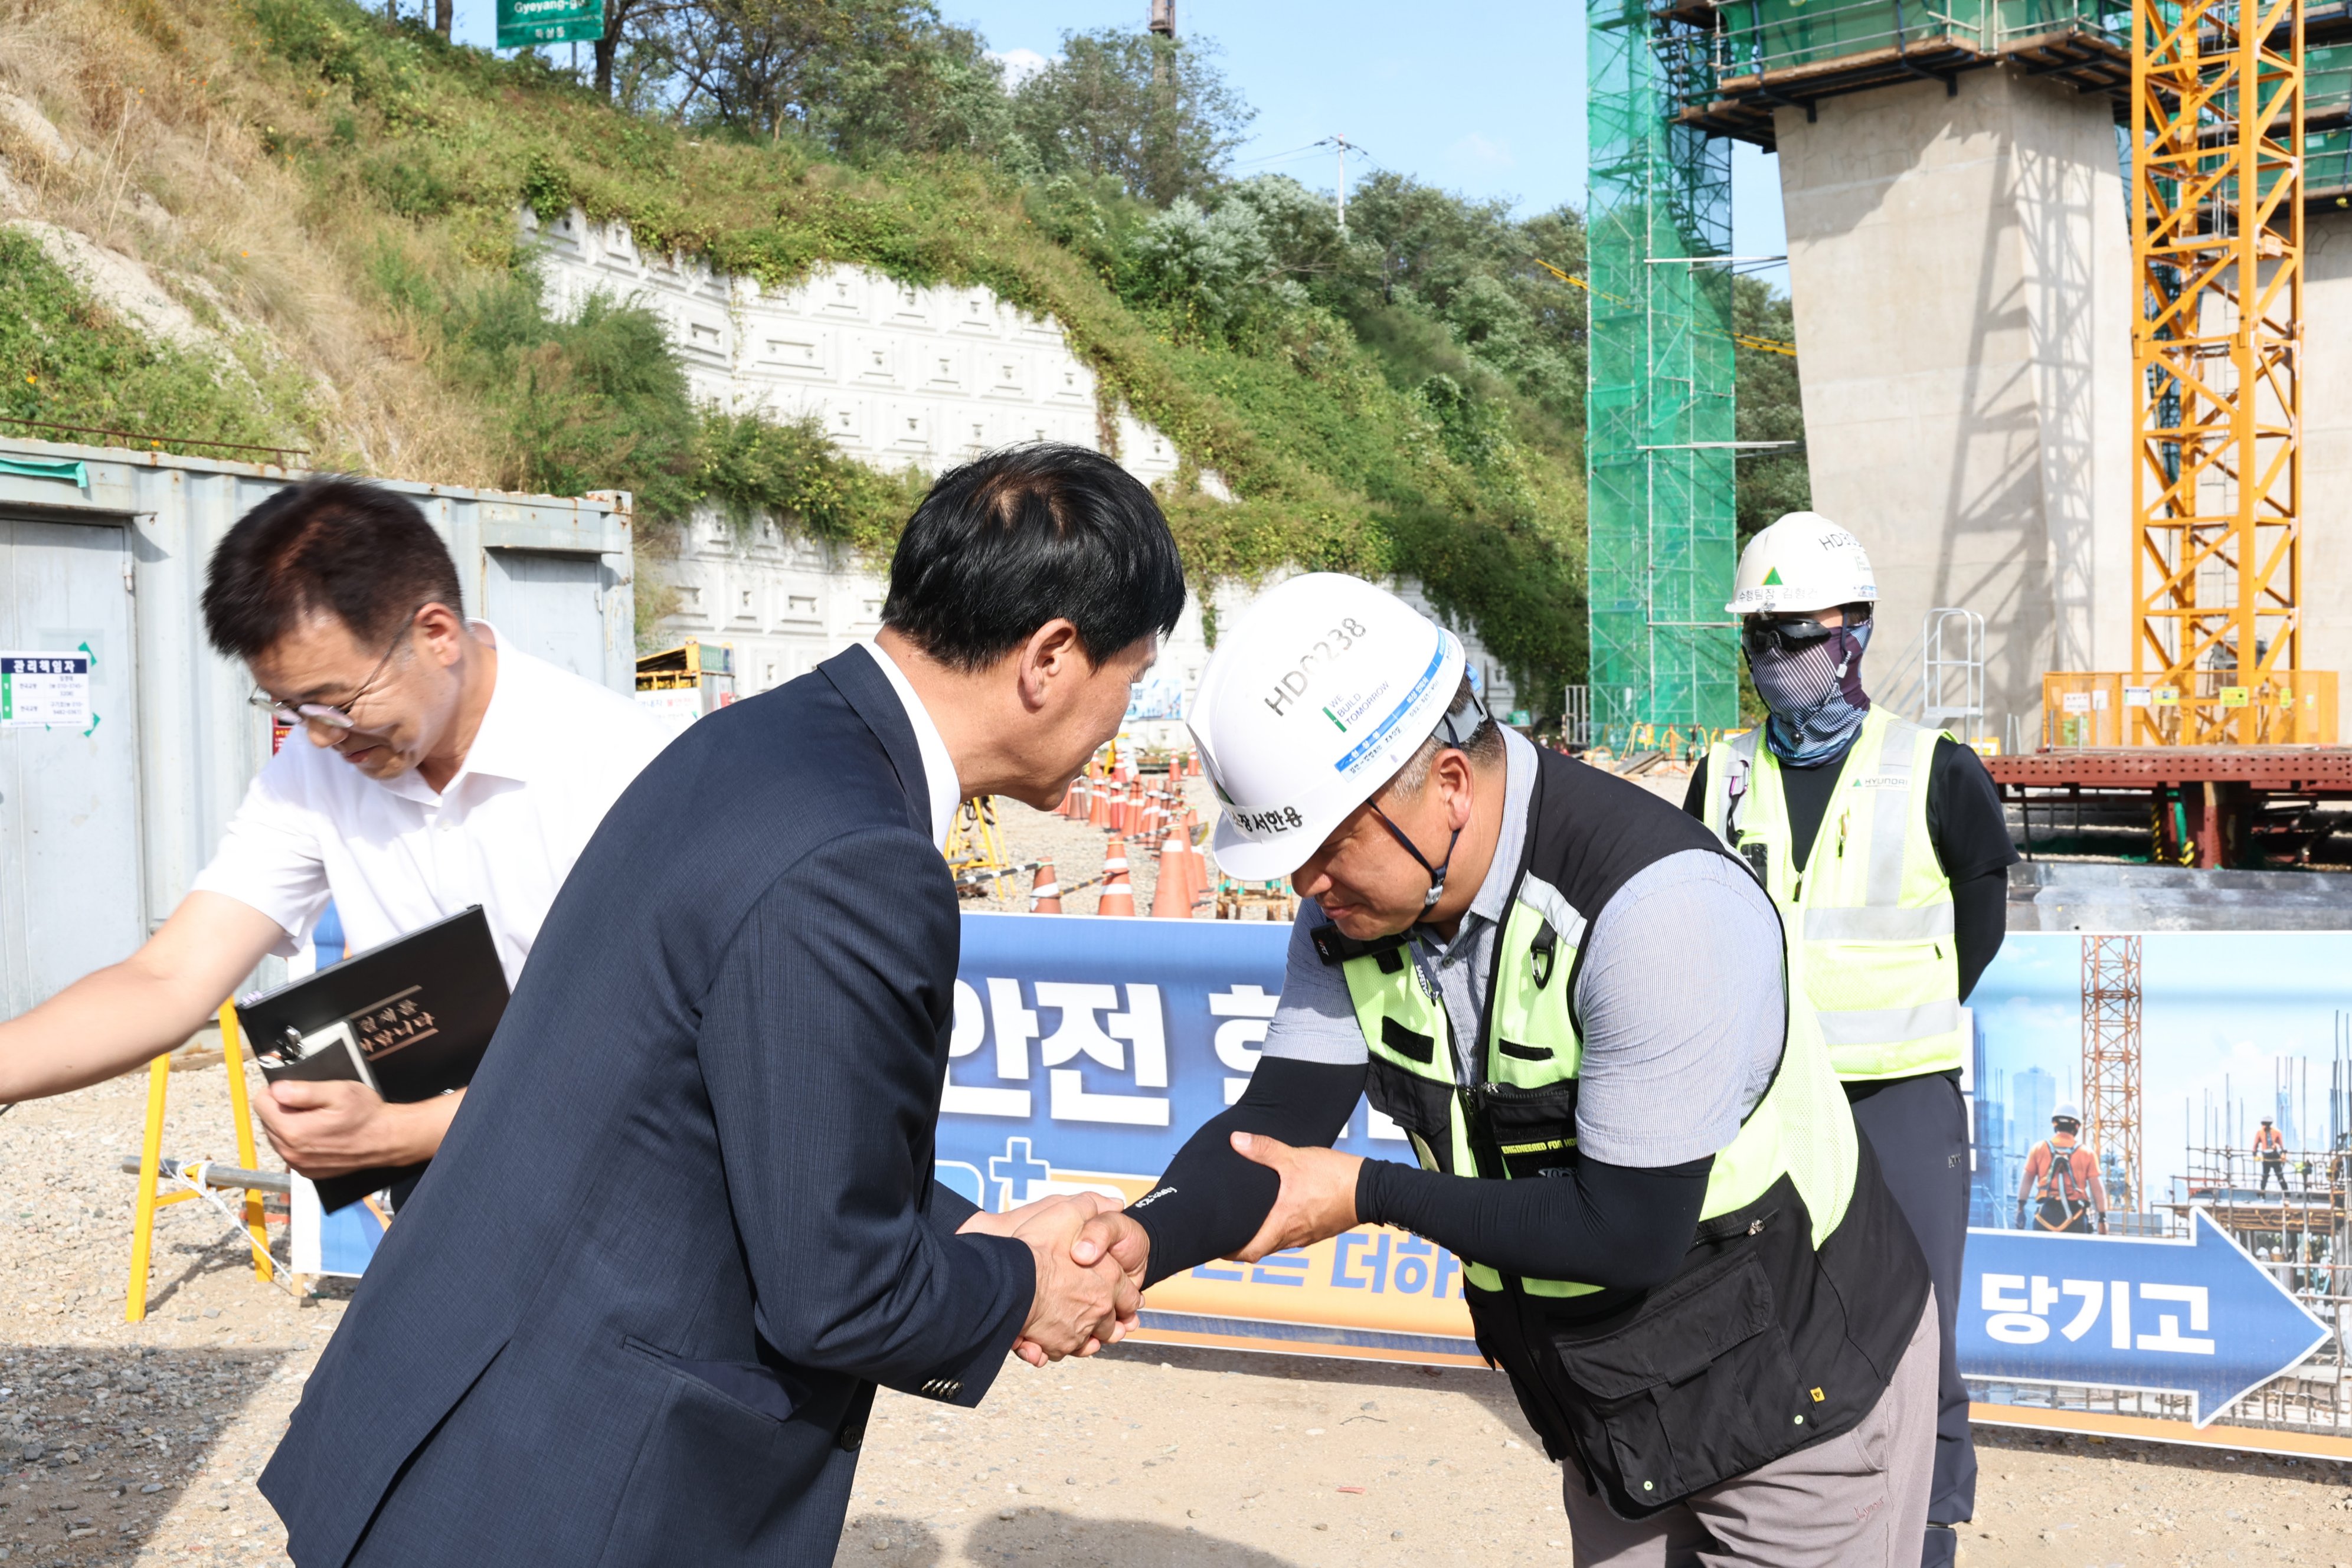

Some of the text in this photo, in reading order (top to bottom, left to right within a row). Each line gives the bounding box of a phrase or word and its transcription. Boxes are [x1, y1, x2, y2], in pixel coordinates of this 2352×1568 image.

[14, 660, 75, 673] 관리책임자
[1264, 618, 1366, 716] HD0238
[1329, 694, 1344, 709] WE
[1337, 693, 1361, 719] BUILD
[1345, 681, 1390, 726] TOMORROW
[1252, 806, 1303, 833] 서한용
[941, 977, 1169, 1125] 안전
[1501, 1142, 1547, 1154] ENGINEERED
[1548, 1140, 1563, 1150] FOR
[1330, 1232, 1465, 1299] 더하
[1981, 1273, 2214, 1354] 당기고
